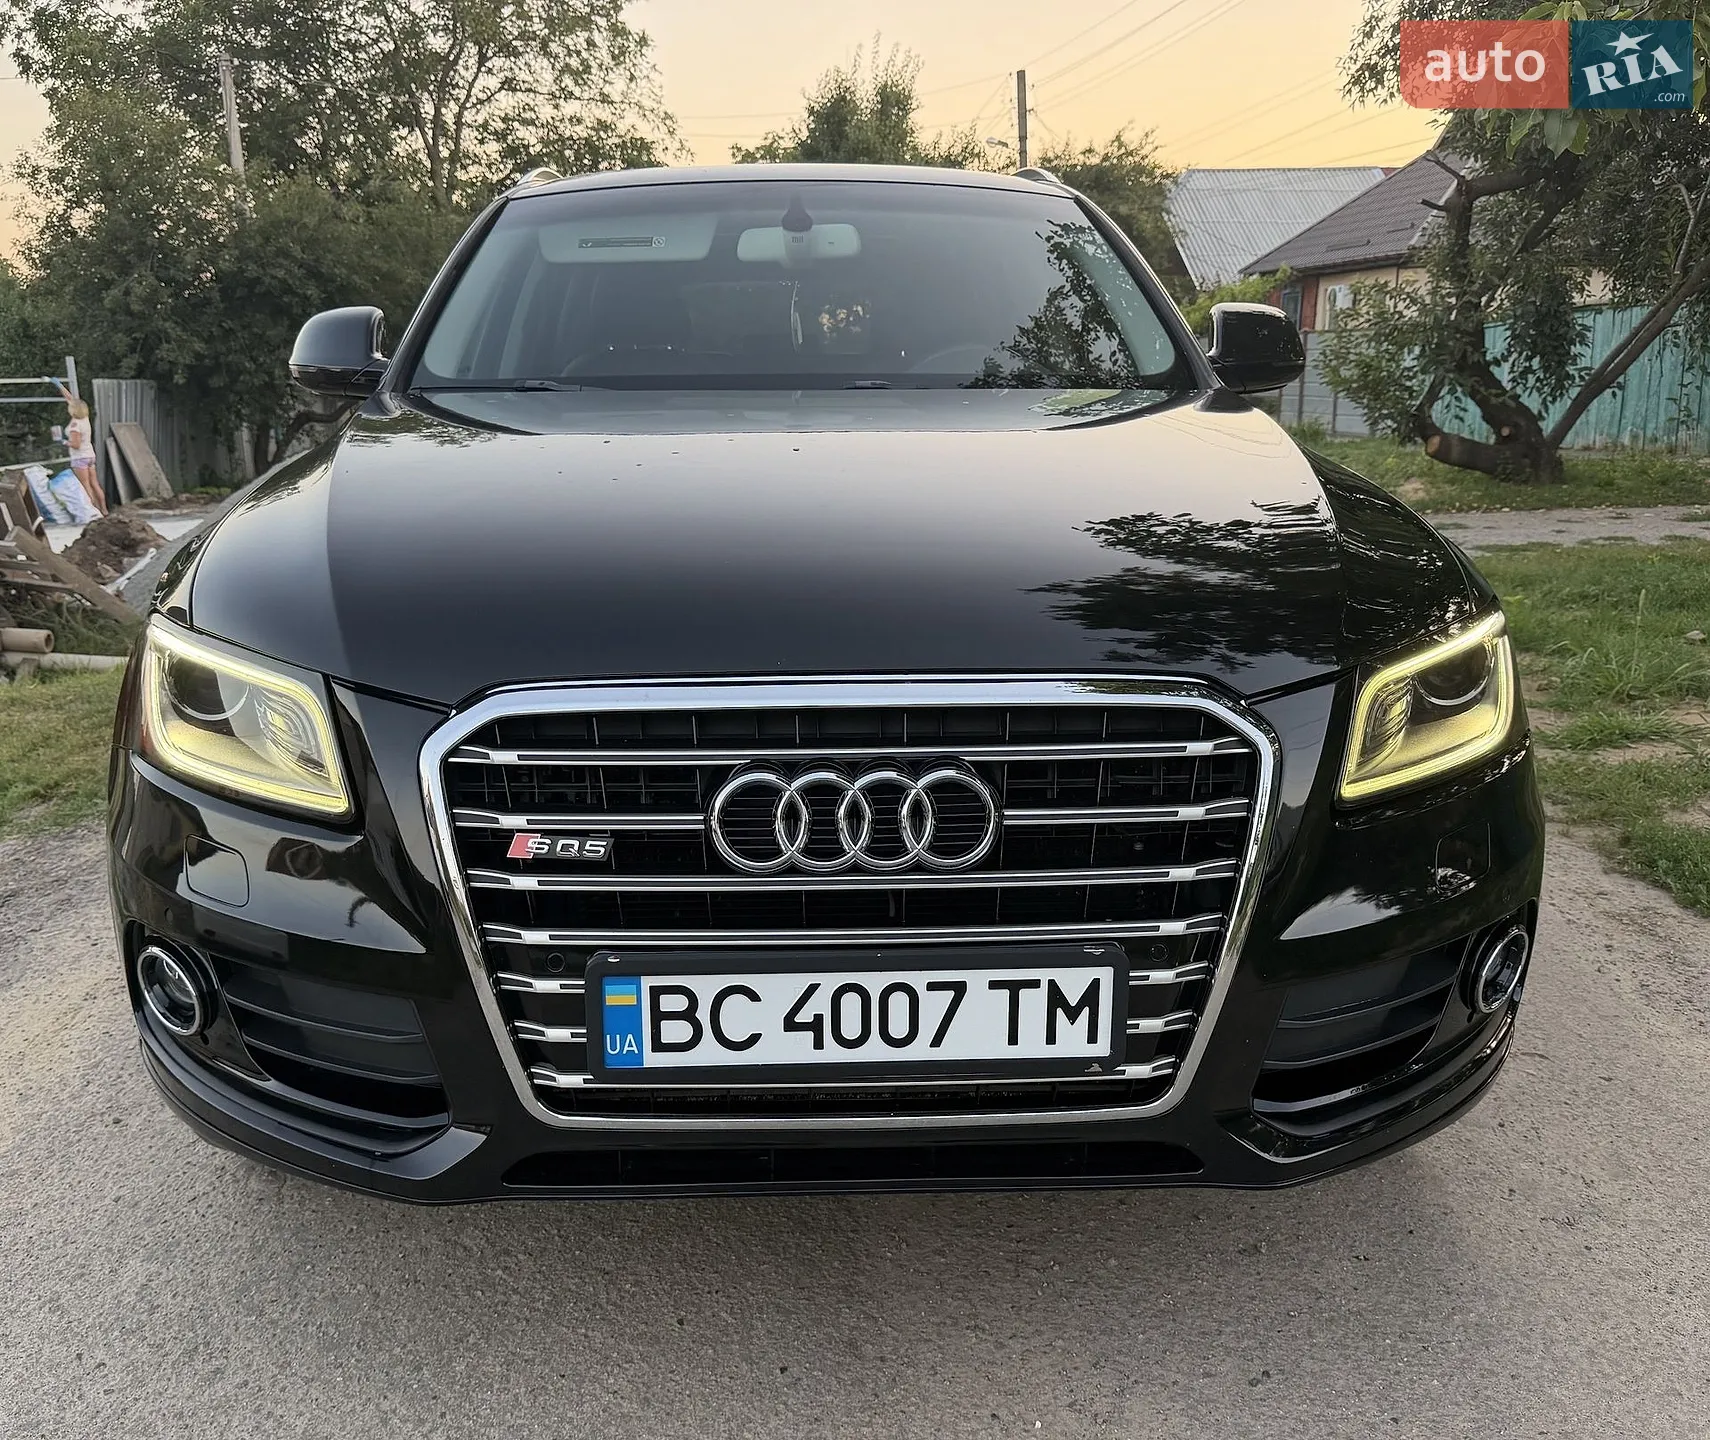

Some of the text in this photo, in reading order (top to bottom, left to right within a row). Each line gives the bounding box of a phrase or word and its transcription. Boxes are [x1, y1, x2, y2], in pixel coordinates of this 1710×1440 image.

[525, 838, 608, 858] SQ5
[648, 977, 1101, 1053] BC 4007 TM
[606, 1033, 639, 1056] UA
